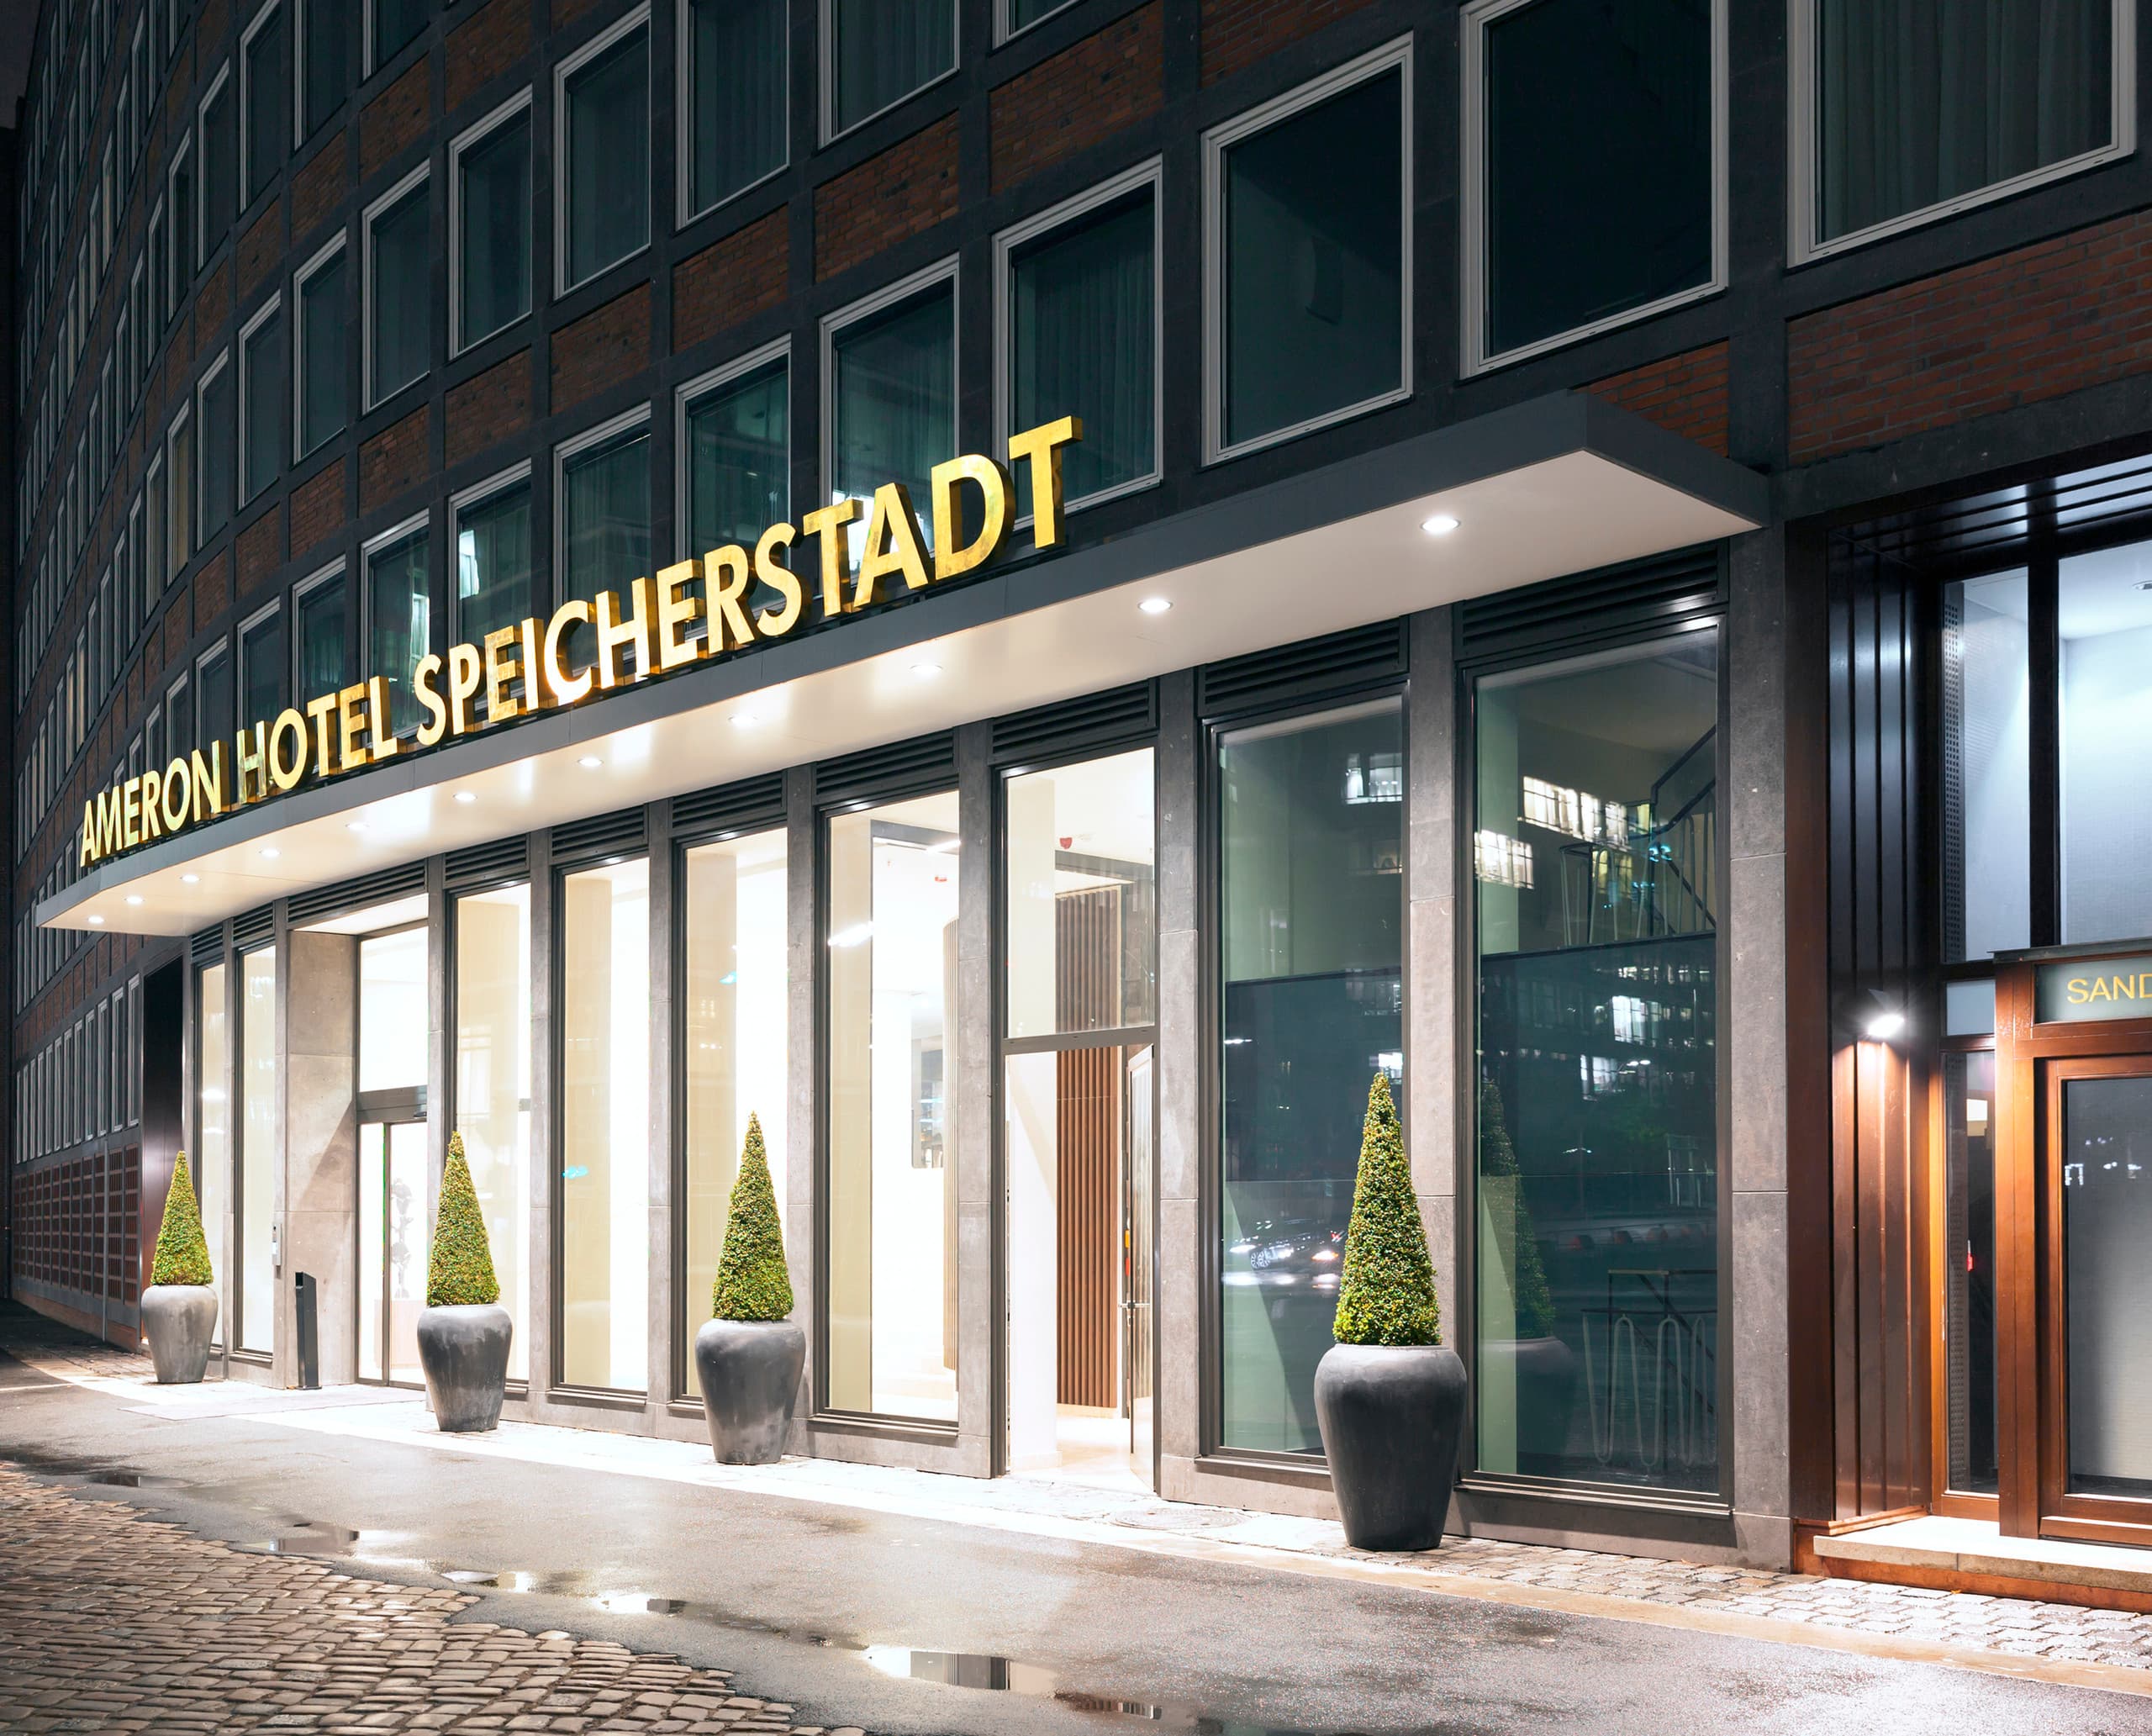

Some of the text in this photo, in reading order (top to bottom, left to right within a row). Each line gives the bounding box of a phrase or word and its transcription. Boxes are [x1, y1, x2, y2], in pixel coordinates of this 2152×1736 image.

[80, 416, 1083, 867] AMERON HOTEL SPEICHERSTADT
